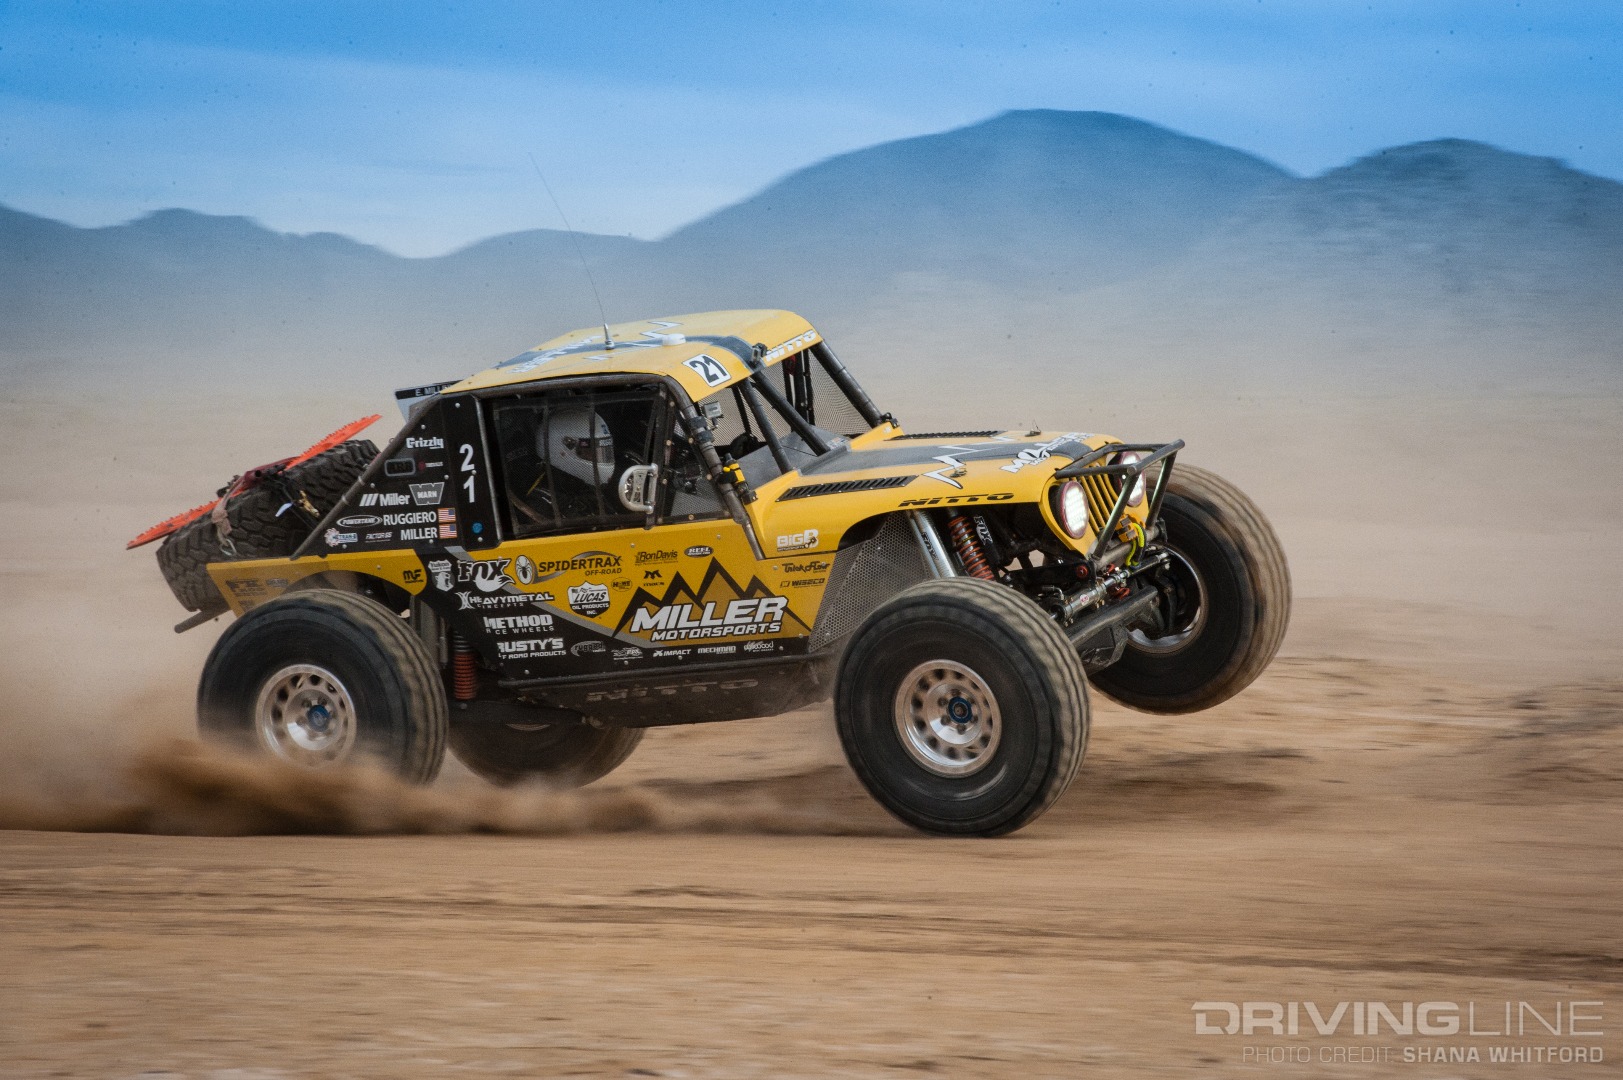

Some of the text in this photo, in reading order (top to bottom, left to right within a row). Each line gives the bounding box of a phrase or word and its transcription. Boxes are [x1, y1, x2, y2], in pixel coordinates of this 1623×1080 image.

[766, 330, 817, 362] NITTO
[689, 356, 728, 383] 21
[406, 437, 444, 449] Grizzly
[380, 493, 410, 507] Miller
[417, 490, 437, 499] WARN
[898, 492, 1015, 507] NITTO
[383, 511, 437, 526] RUGGIERO
[400, 528, 437, 541] MILLER
[539, 555, 622, 573] SPIDERTRAX
[457, 558, 514, 586] FOX
[585, 567, 622, 576] OFF-ROAD
[574, 592, 606, 603] LUCAS
[629, 595, 789, 633] MILLER
[484, 614, 553, 629] METHOD
[513, 625, 555, 634] WHEELS
[650, 622, 782, 642] MOTORSPORTS
[530, 650, 567, 658] PRODUCTS
[663, 648, 692, 656] IMPACT
[697, 645, 737, 654] MECHMAN
